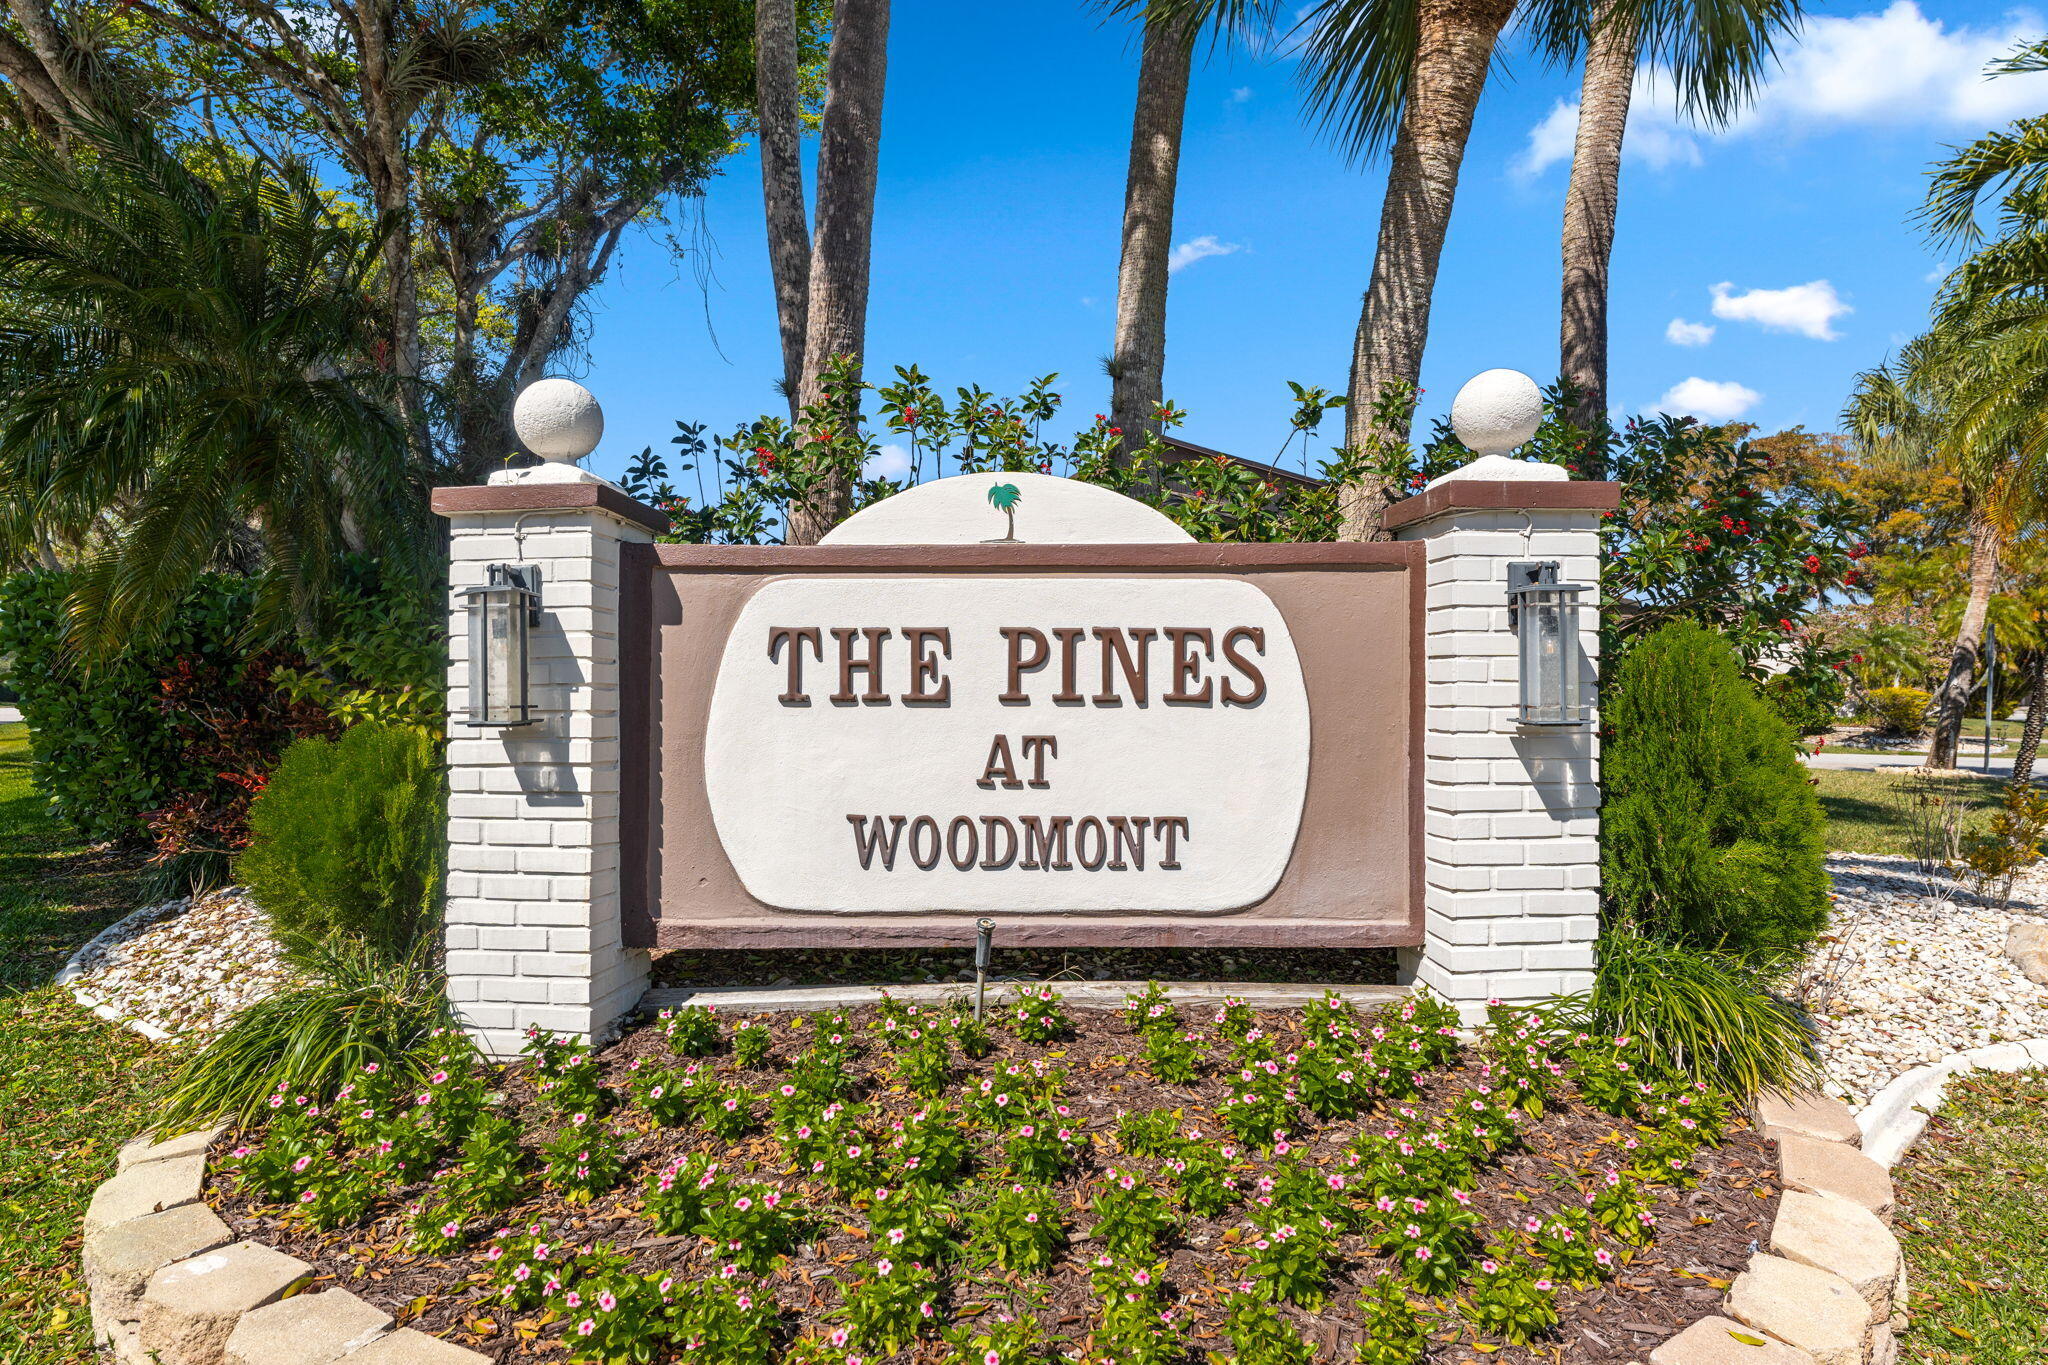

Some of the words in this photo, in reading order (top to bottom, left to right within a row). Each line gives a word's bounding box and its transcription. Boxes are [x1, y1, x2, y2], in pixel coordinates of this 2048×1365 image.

[768, 626, 952, 708] THE
[999, 626, 1266, 709] PINES
[977, 734, 1058, 790] AT
[846, 814, 1190, 873] WOODMONT
